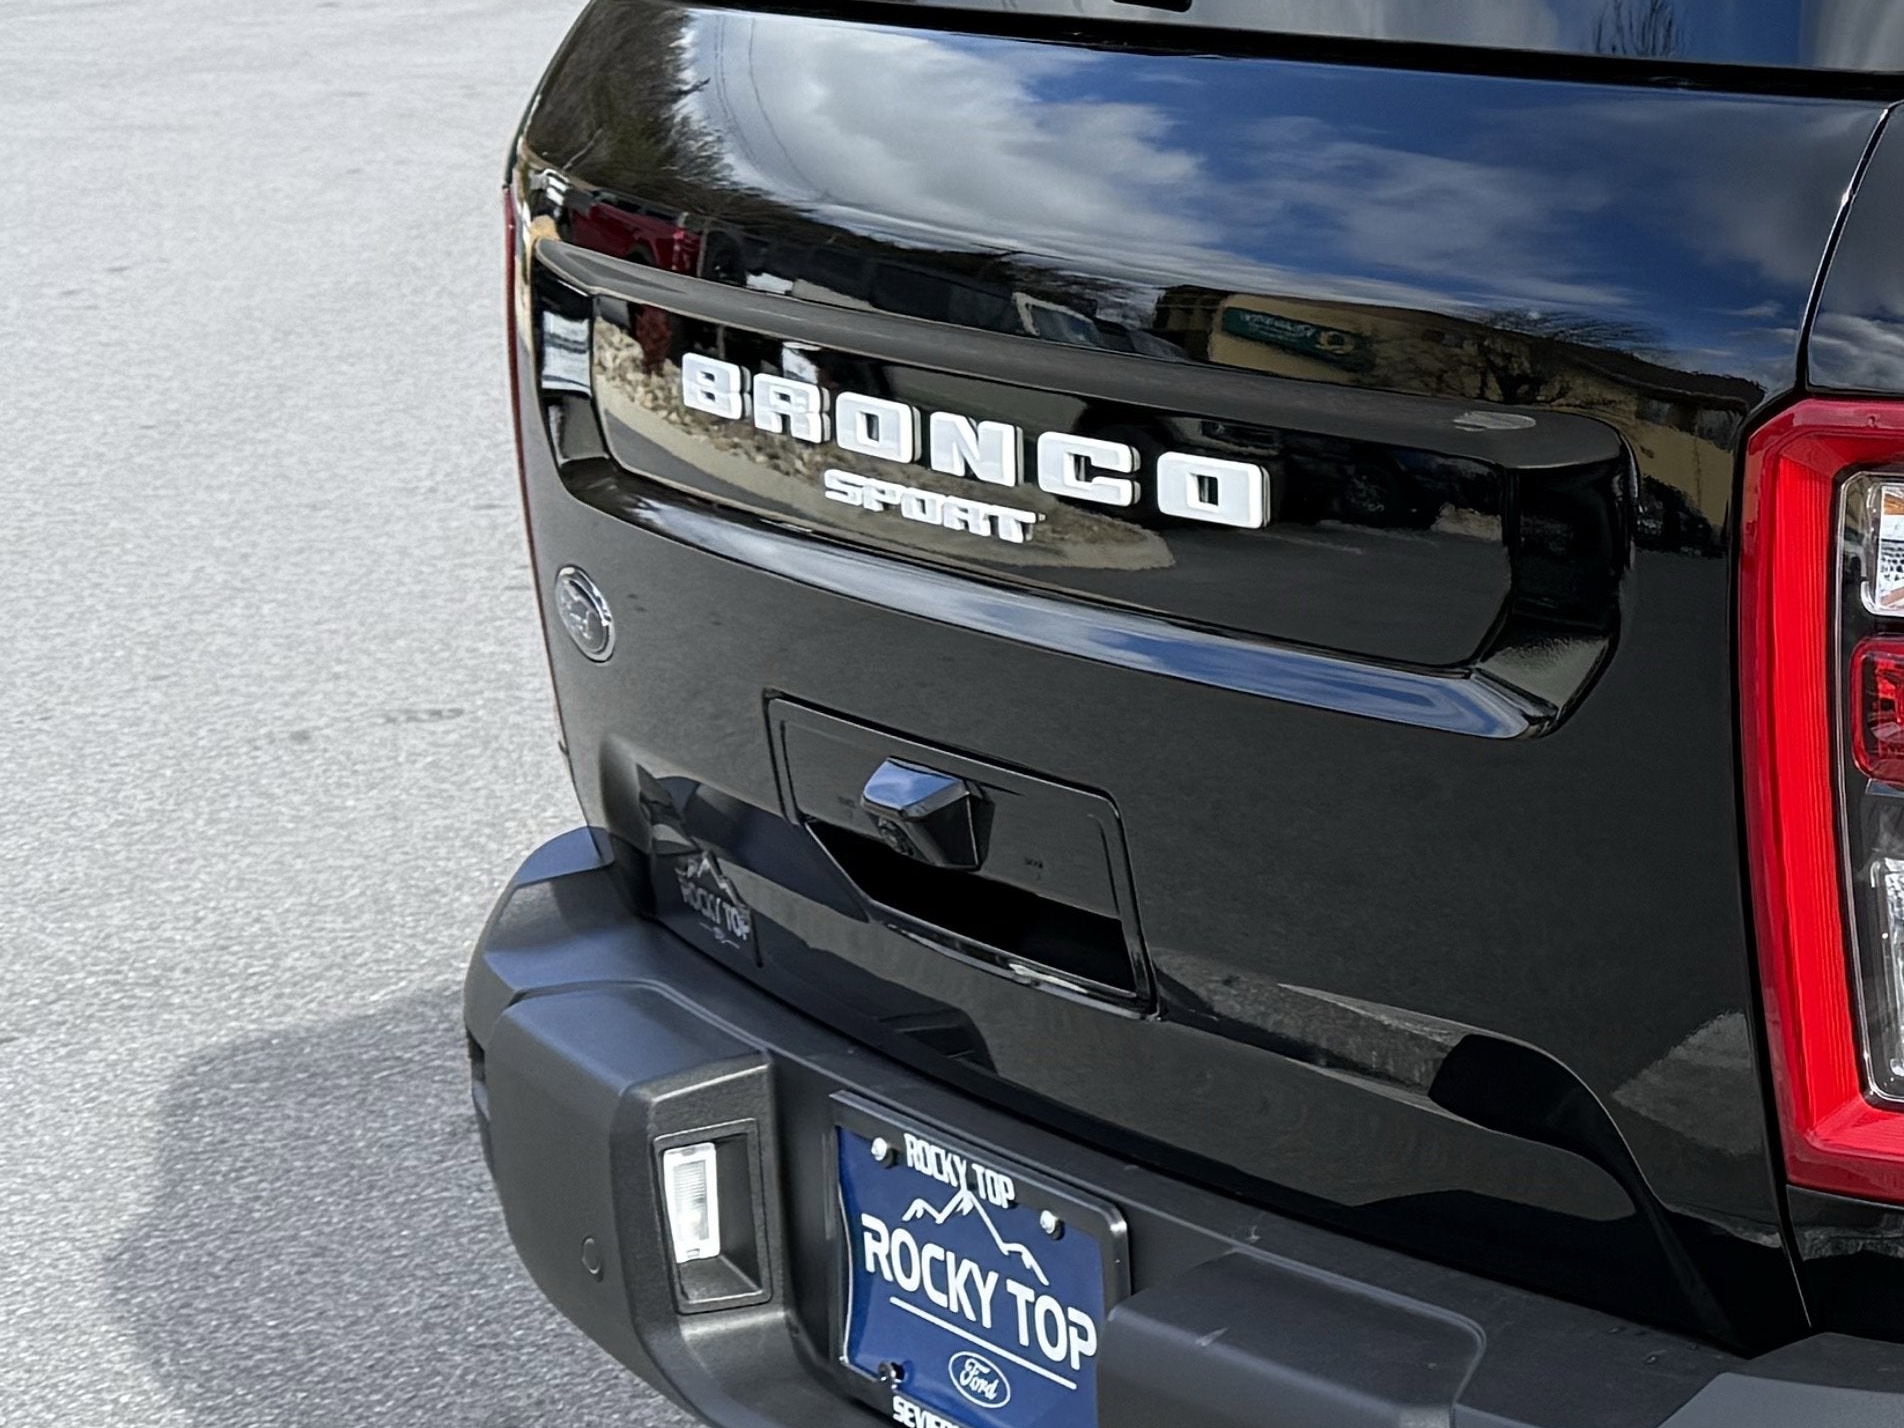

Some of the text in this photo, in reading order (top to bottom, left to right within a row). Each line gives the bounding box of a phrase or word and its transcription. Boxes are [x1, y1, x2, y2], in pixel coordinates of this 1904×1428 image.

[681, 351, 1271, 530] BRONCO
[824, 468, 1044, 544] SPORT
[903, 1132, 1016, 1209] ROCKY TOP
[861, 1212, 1098, 1371] ROCKY TOP
[957, 1355, 1001, 1403] Ford
